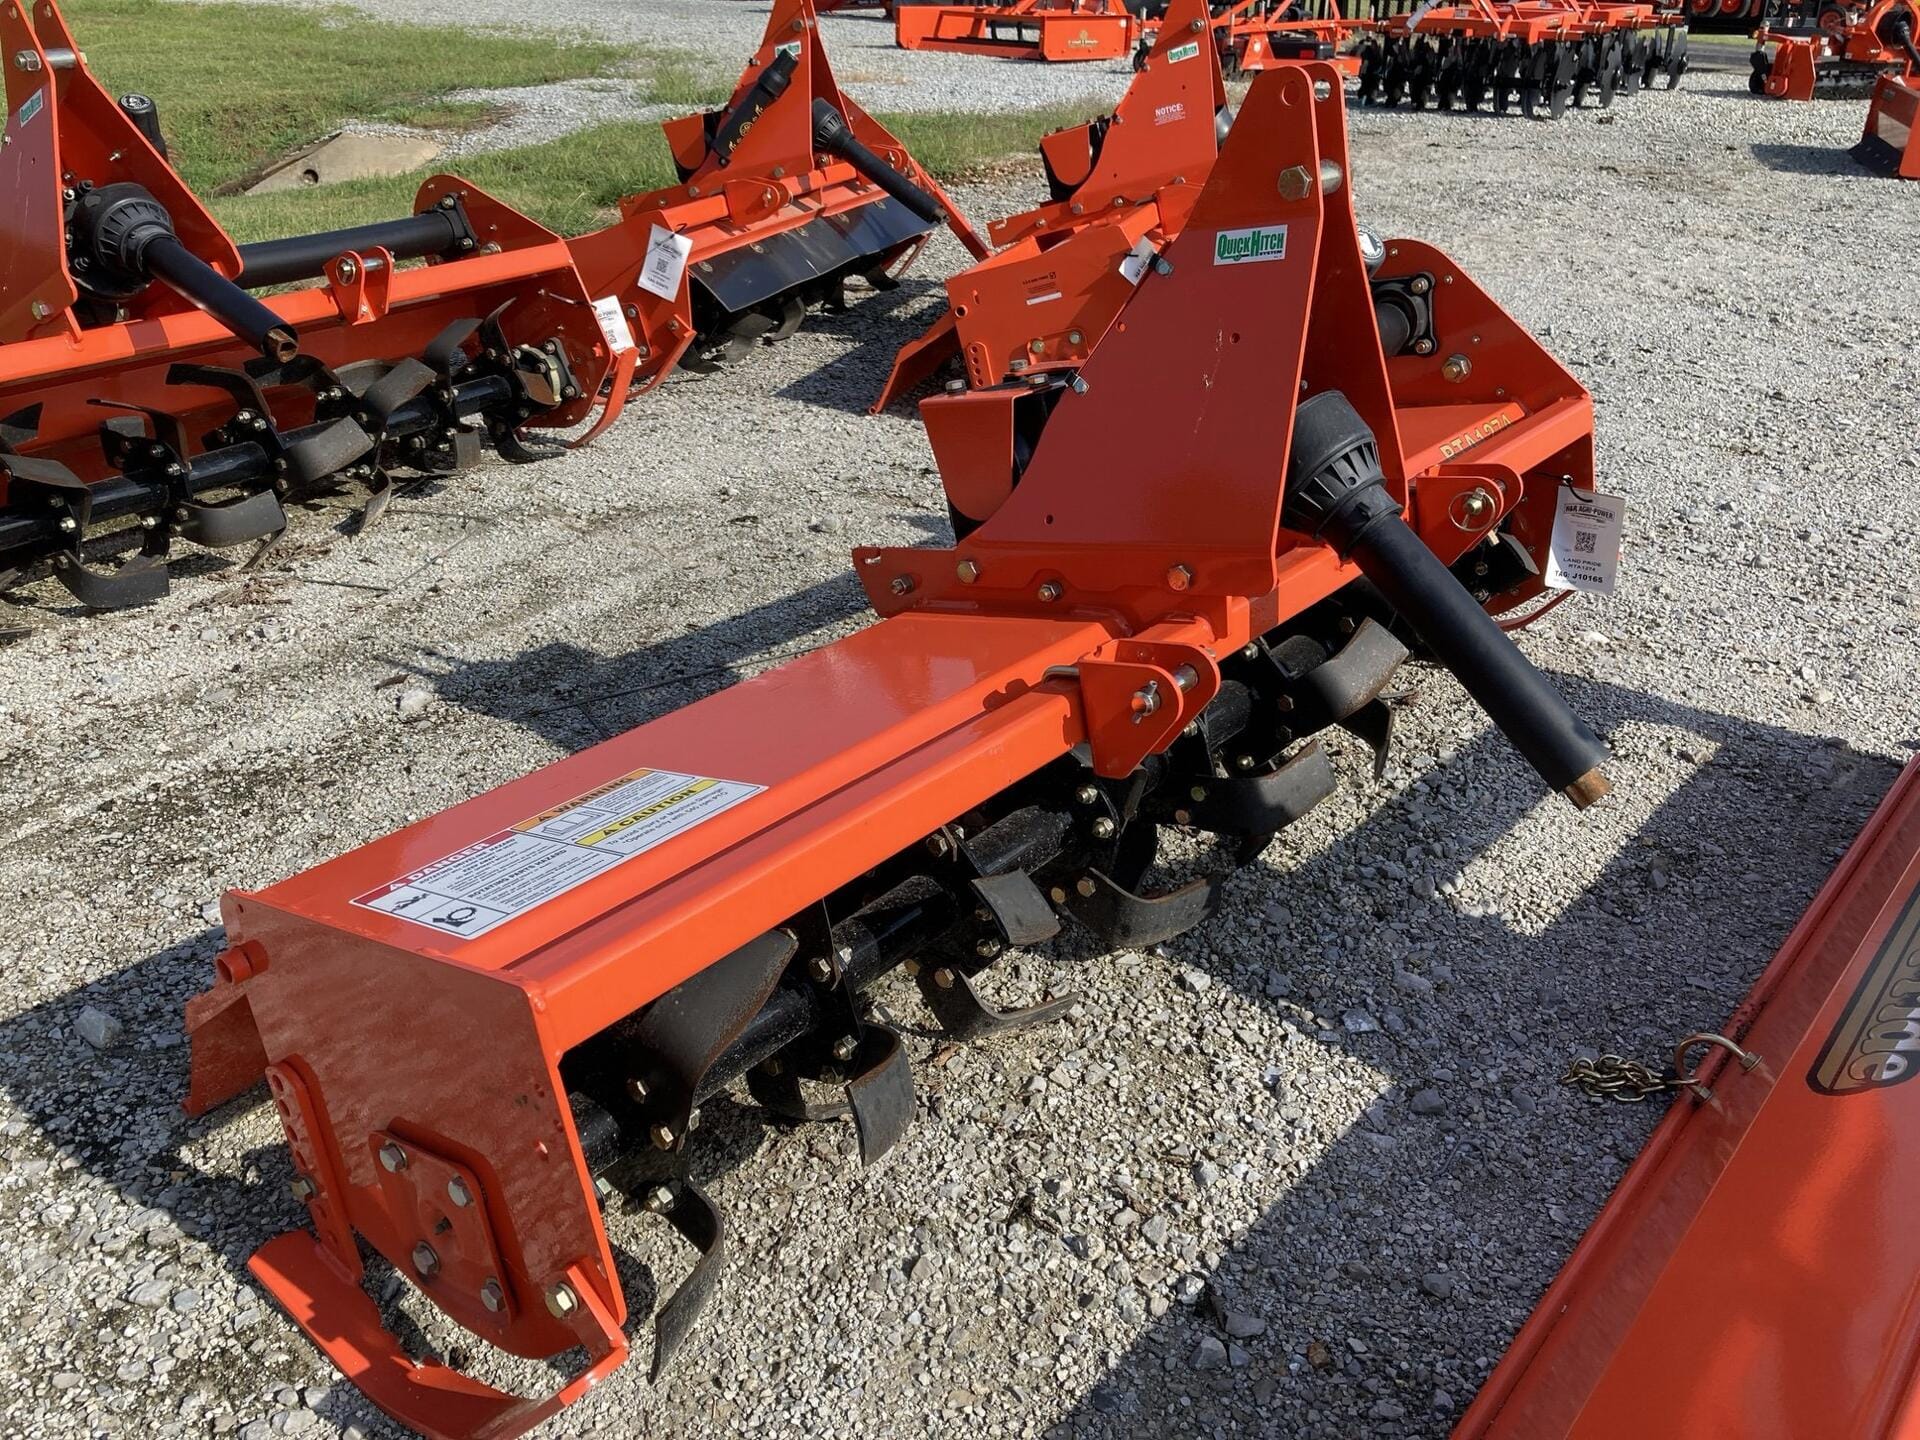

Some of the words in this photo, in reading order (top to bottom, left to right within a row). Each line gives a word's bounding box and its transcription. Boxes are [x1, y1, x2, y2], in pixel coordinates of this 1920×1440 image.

[553, 778, 632, 812] WARNING
[616, 789, 697, 826] CAUTION
[405, 842, 491, 880] DANGER
